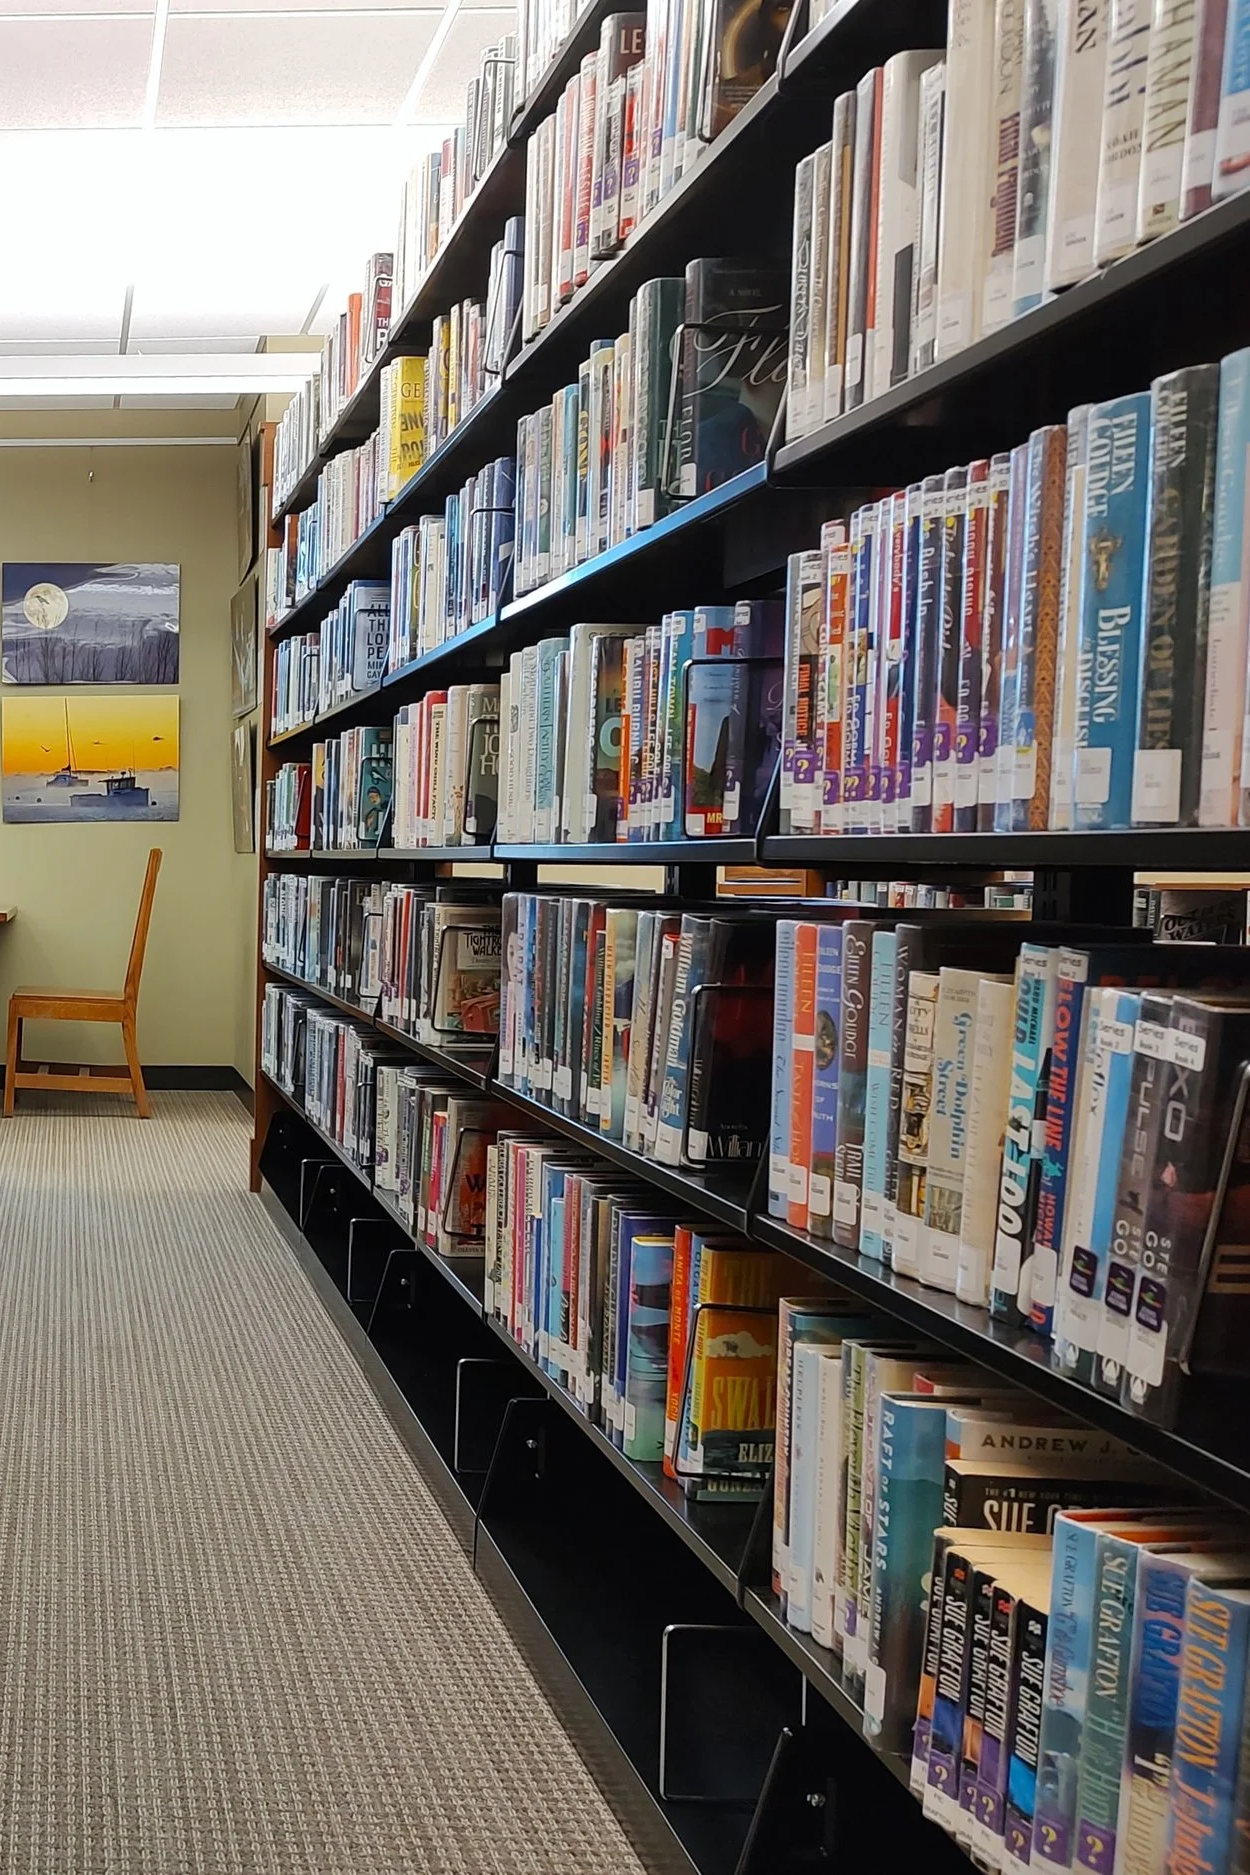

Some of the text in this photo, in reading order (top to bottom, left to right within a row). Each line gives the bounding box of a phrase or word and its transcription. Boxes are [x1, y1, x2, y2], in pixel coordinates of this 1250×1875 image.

[1086, 420, 1114, 518] GOUDGE
[1113, 411, 1139, 495] EILEEN
[1092, 604, 1131, 724] BLESSING
[795, 663, 811, 738] FINAL NOTICE
[630, 703, 642, 765] BURNING
[597, 946, 605, 984] William
[800, 950, 816, 1014] EILEEN
[843, 934, 868, 1059] EILEEN GOUDGE
[890, 943, 909, 1032] WOMAN
[594, 986, 604, 1026] Golding
[665, 932, 693, 1068] William Goldman
[1099, 1022, 1125, 1038] Series
[1137, 1023, 1165, 1040] Series
[1174, 1036, 1199, 1053] Series
[889, 1065, 902, 1111] RED
[936, 1057, 956, 1117] Street
[949, 1011, 974, 1161] Green Dolphin
[1007, 1050, 1035, 1154] LAST
[1044, 1062, 1070, 1151] THE LINE
[674, 1253, 685, 1286] ANITA
[673, 1305, 683, 1345] MONTE
[878, 1410, 895, 1471] RAFT
[980, 1433, 1089, 1453] ANDREW
[875, 1499, 891, 1571] STARS
[982, 1499, 1037, 1536] SUE
[872, 1586, 884, 1640] ANDREW
[1060, 1555, 1078, 1608] GRAFTON
[1145, 1566, 1187, 1613] SUE
[939, 1595, 968, 1702] SUE GRAFTON
[1094, 1551, 1129, 1701] SUE GRAFTON
[983, 1630, 1012, 1741] SUE GRAFTON
[1014, 1650, 1044, 1766] SUE GRAFTON
[1174, 1594, 1230, 1775] SUE GRAFTON
